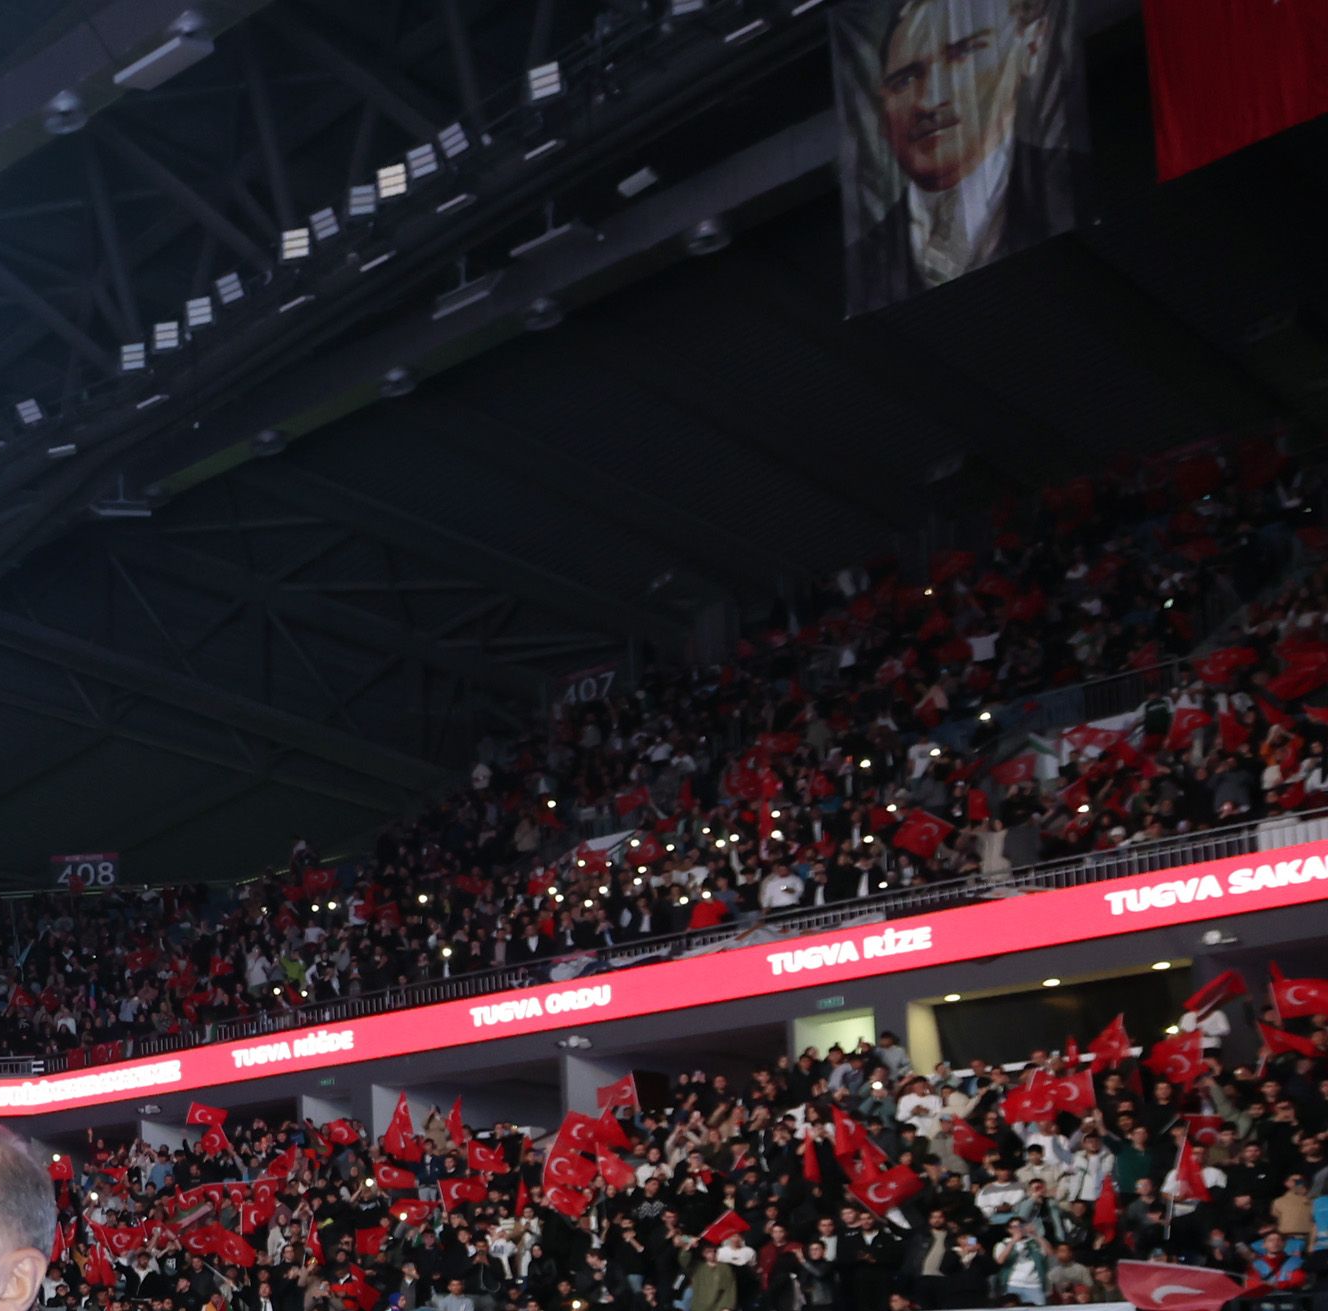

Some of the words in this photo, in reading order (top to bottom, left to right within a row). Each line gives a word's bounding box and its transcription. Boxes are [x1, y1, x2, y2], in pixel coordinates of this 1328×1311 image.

[1104, 875, 1223, 915] TUGVA
[1228, 855, 1328, 894] SAKA
[767, 941, 859, 975] TUGVA
[863, 927, 932, 958] RİZE
[470, 997, 543, 1027] TUGVA
[545, 985, 611, 1014] ORDU
